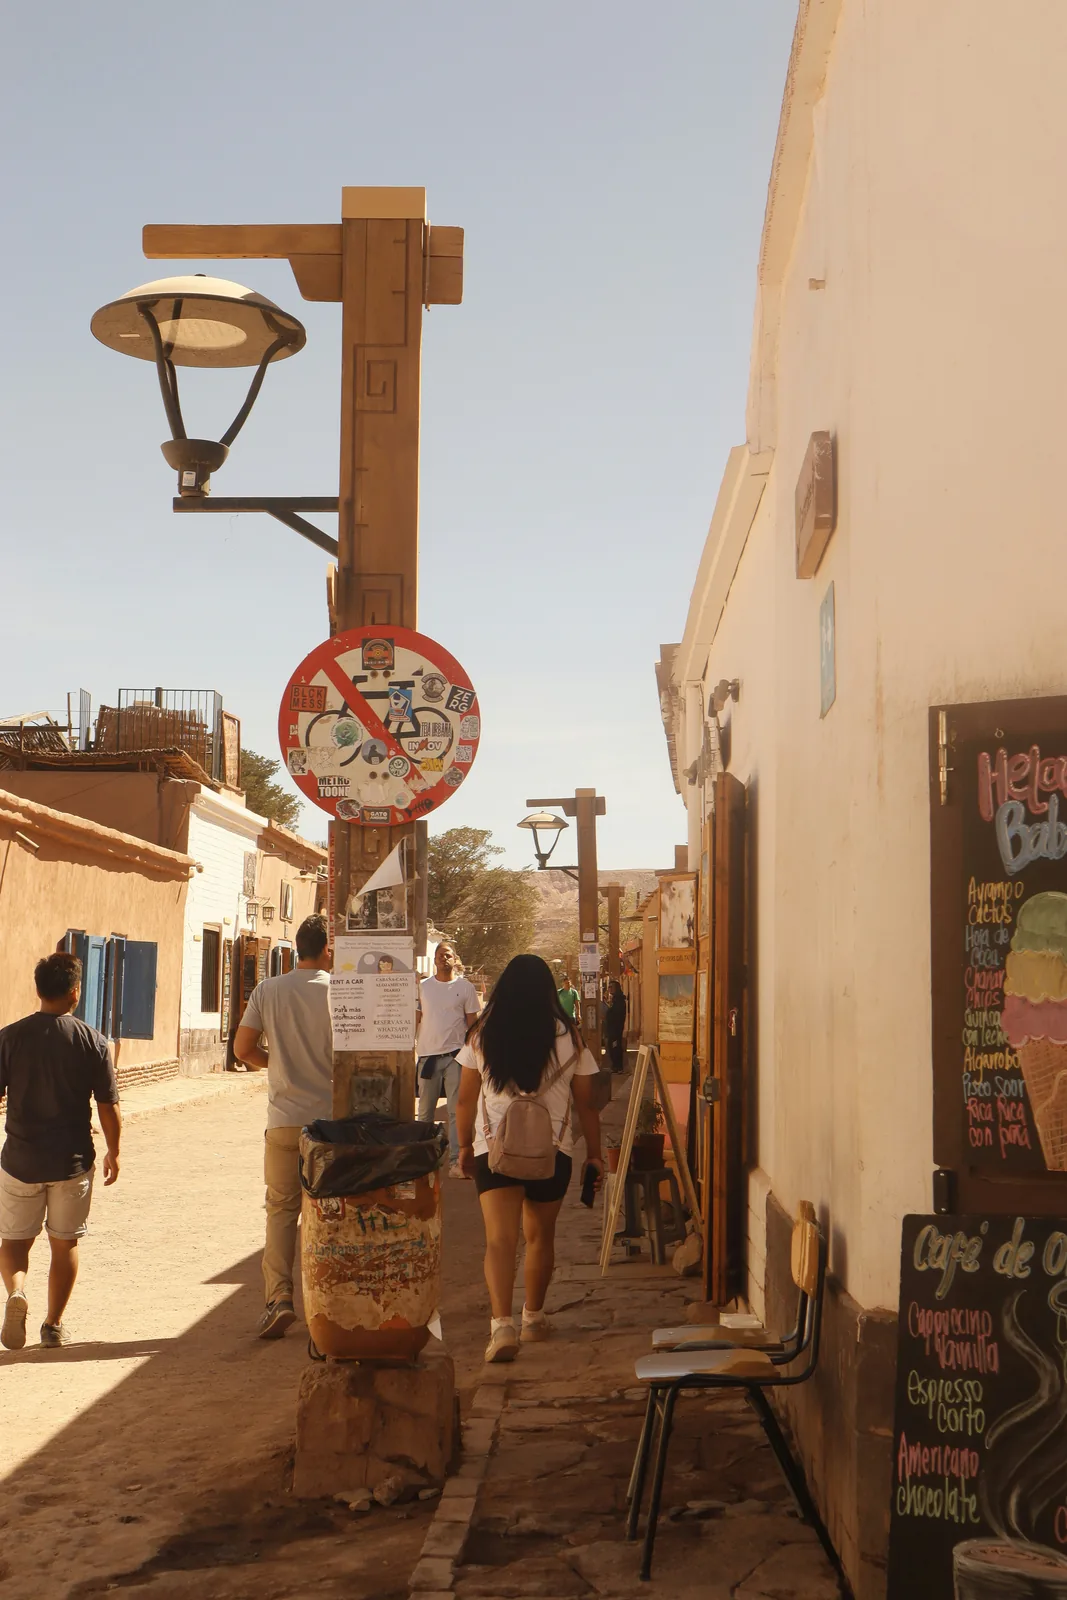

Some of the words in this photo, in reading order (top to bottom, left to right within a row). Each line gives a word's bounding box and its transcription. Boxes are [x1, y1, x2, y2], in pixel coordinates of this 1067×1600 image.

[292, 697, 323, 709] MESS
[294, 687, 324, 699] BLCK
[453, 689, 472, 702] ZE
[449, 699, 468, 712] RG
[965, 925, 990, 951] Hoja
[994, 921, 1010, 945] de
[962, 1073, 991, 1104] Pisco
[967, 1097, 994, 1125] Rica
[969, 1127, 993, 1147] con
[913, 1220, 990, 1300] Café
[993, 1216, 1035, 1279] de
[1043, 1231, 1067, 1276] O
[897, 1431, 979, 1482] Americano
